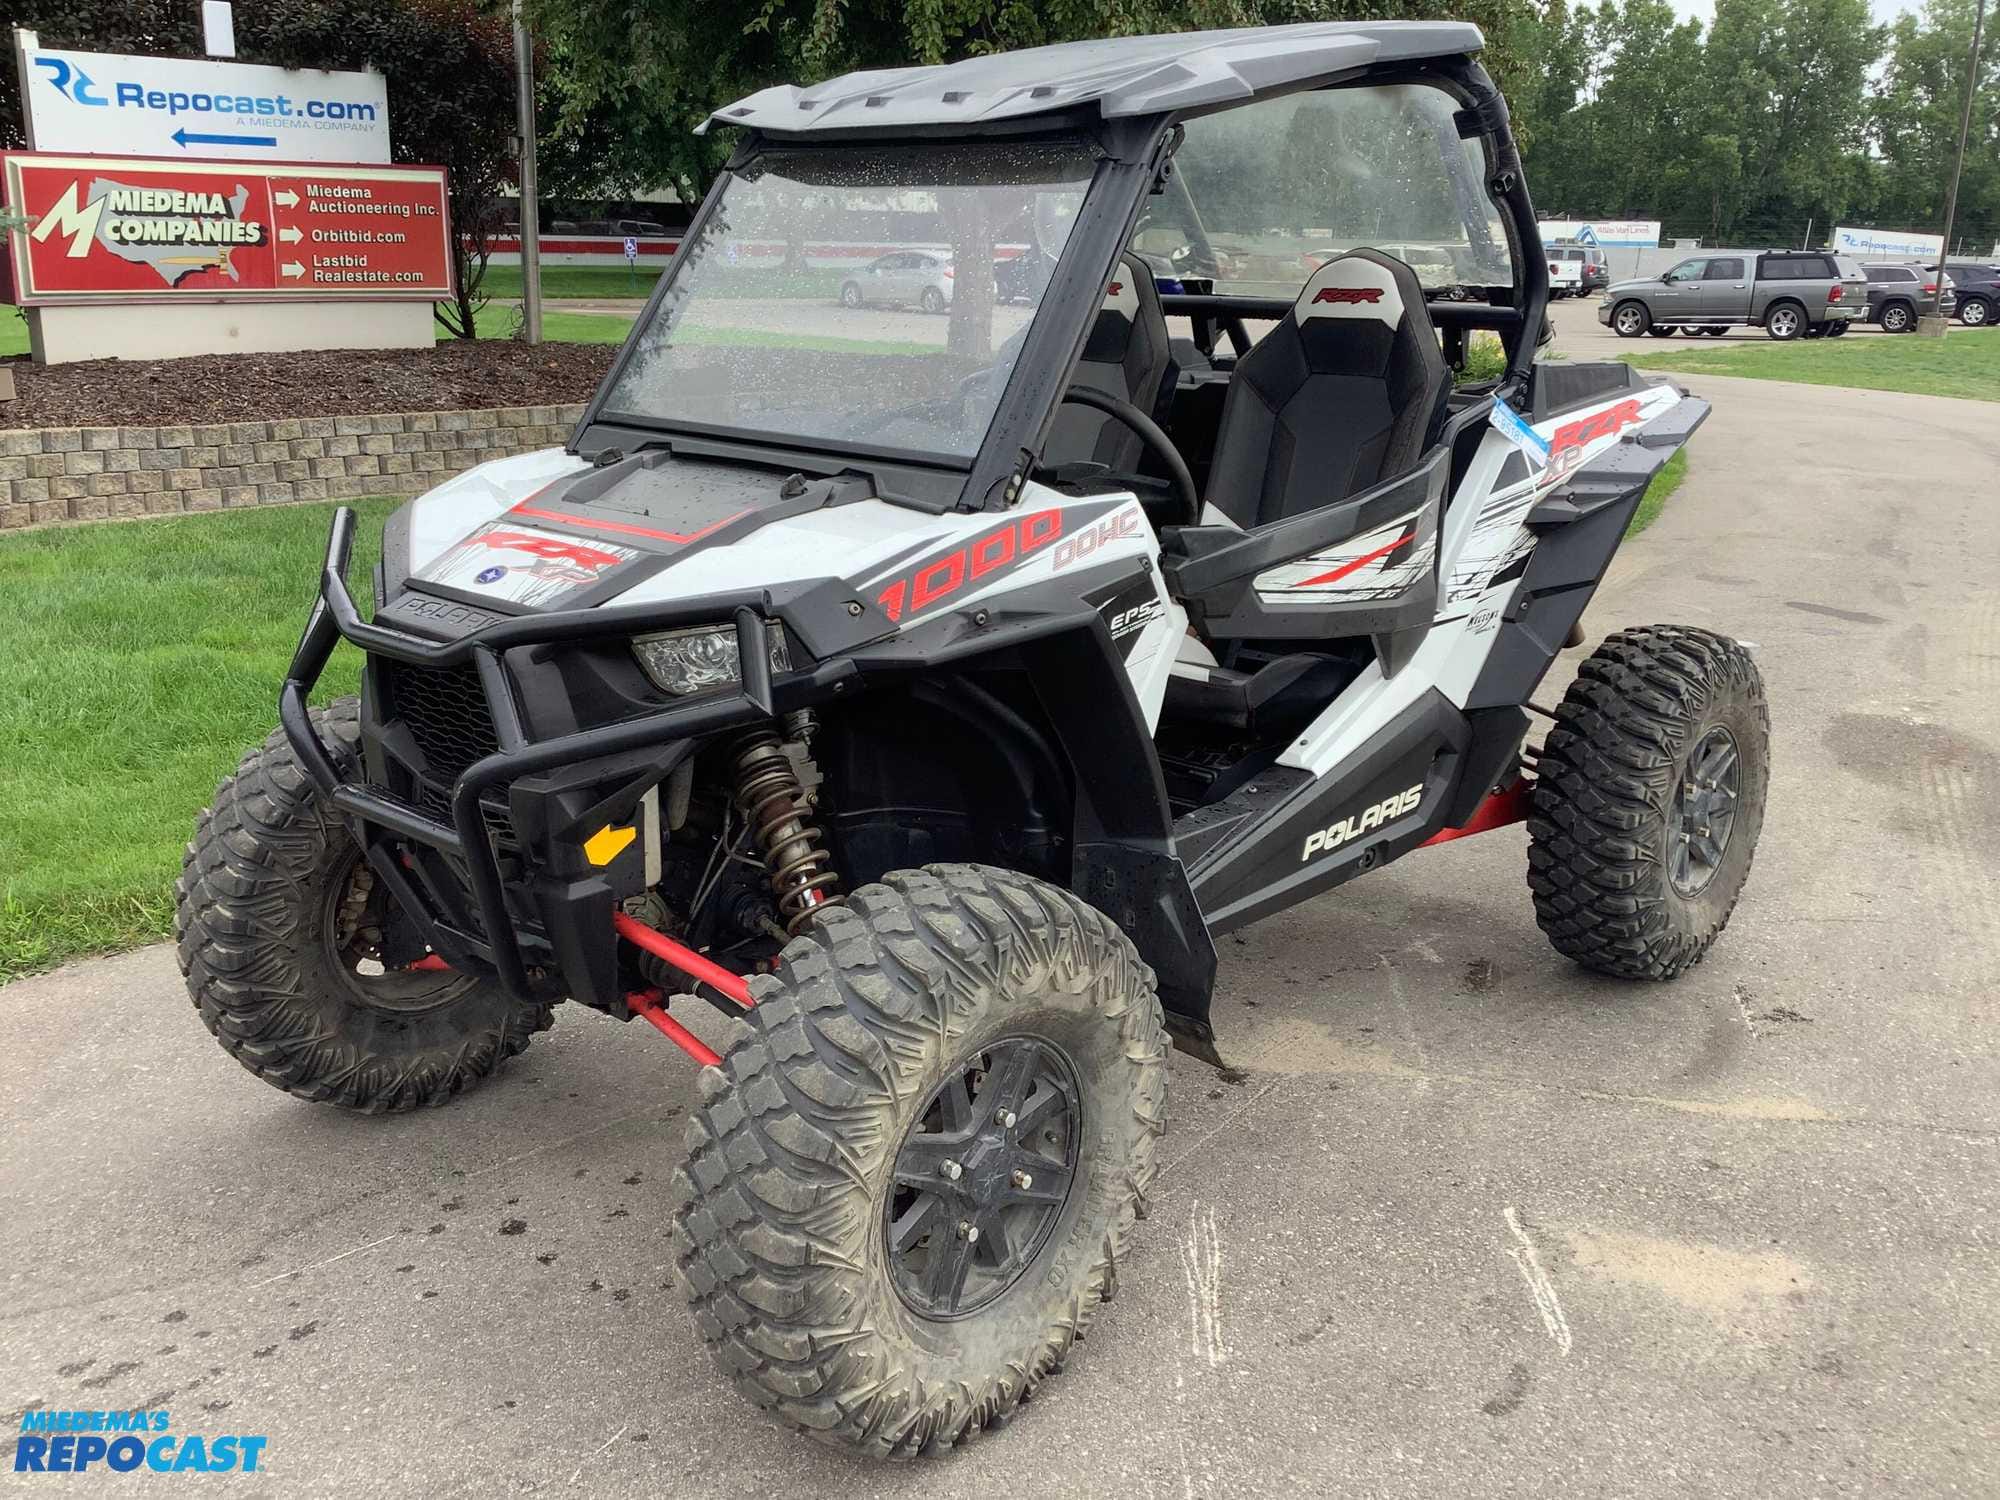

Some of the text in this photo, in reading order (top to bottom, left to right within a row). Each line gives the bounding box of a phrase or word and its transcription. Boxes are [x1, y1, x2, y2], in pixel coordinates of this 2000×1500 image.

[117, 82, 376, 121] Repocast.com
[236, 117, 376, 132] A MIEDEMA COMPANY
[109, 190, 229, 215] MIEDEMA
[306, 184, 373, 199] Miedema
[308, 199, 440, 218] Auctioneering Inc.
[104, 219, 262, 243] COMPANIES
[311, 229, 406, 243] Orbitbid.com
[313, 254, 368, 267] Lastbid
[314, 269, 424, 283] Realestate.com
[1551, 399, 1644, 452] RZR
[1537, 444, 1583, 487] XP
[1053, 506, 1139, 572] DOHC
[877, 507, 1062, 622] 1000
[1110, 600, 1156, 631] EPS
[1302, 783, 1424, 862] POLARIS
